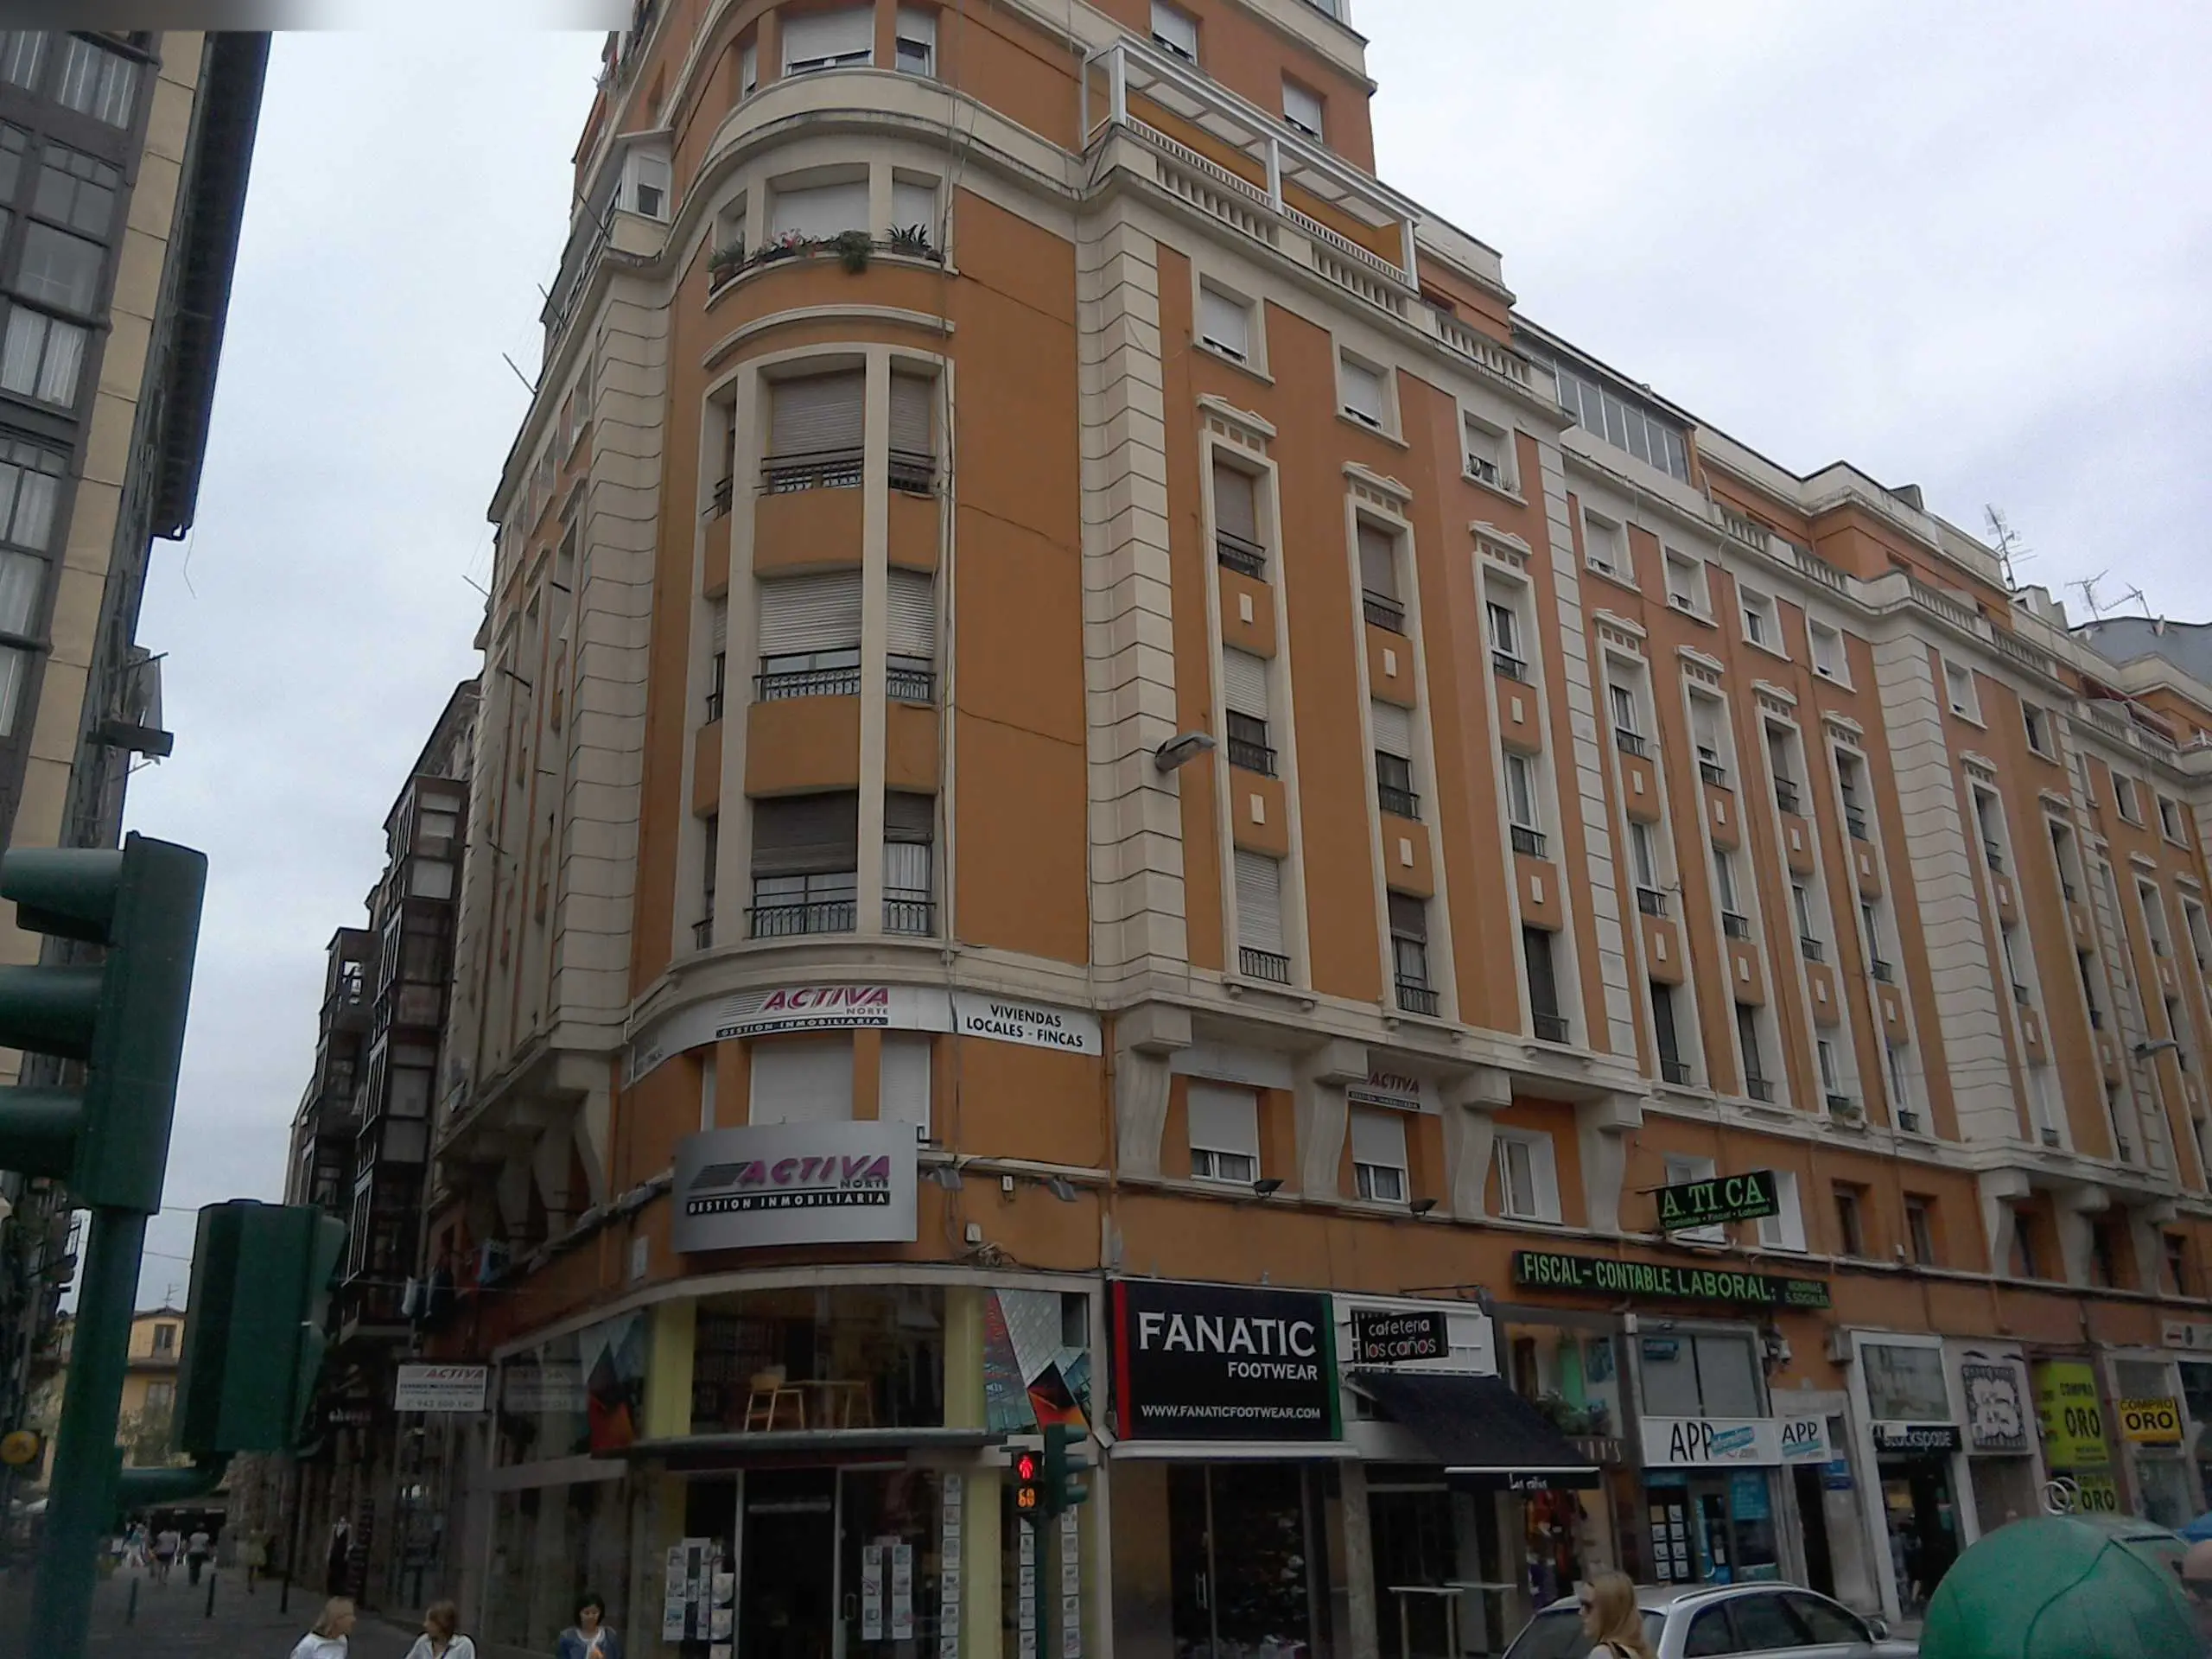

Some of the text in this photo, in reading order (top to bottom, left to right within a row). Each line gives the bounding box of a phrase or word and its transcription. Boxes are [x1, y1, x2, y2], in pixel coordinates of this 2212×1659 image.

[761, 987, 889, 1011] ACTIVA
[721, 1017, 881, 1037] GESTION INMOBILIARIA
[990, 1004, 1062, 1027] VIVIENDAS
[967, 1017, 1023, 1038] LOCALES
[1037, 1029, 1084, 1047] FINCAS
[1369, 1071, 1421, 1094] ACTIVA
[735, 1155, 890, 1186] ACTIVA
[840, 1179, 889, 1189] NORTE
[689, 1192, 886, 1214] GESTION INMOBILIARIA
[1523, 1254, 1582, 1285] FISCAL
[1137, 1311, 1318, 1357] FANATIC
[426, 1368, 484, 1379] ACTIVA
[1228, 1361, 1318, 1381] FOOTWEAR
[1141, 1405, 1321, 1419] WWW.FANATICFOOTWEAR.COM
[2120, 1399, 2173, 1411] COMPRO
[2065, 1407, 2100, 1438] ORO
[2125, 1411, 2174, 1430] ORO
[1669, 1421, 1715, 1461] APP
[1782, 1421, 1818, 1445] APP
[2081, 1490, 2115, 1511] ORO
